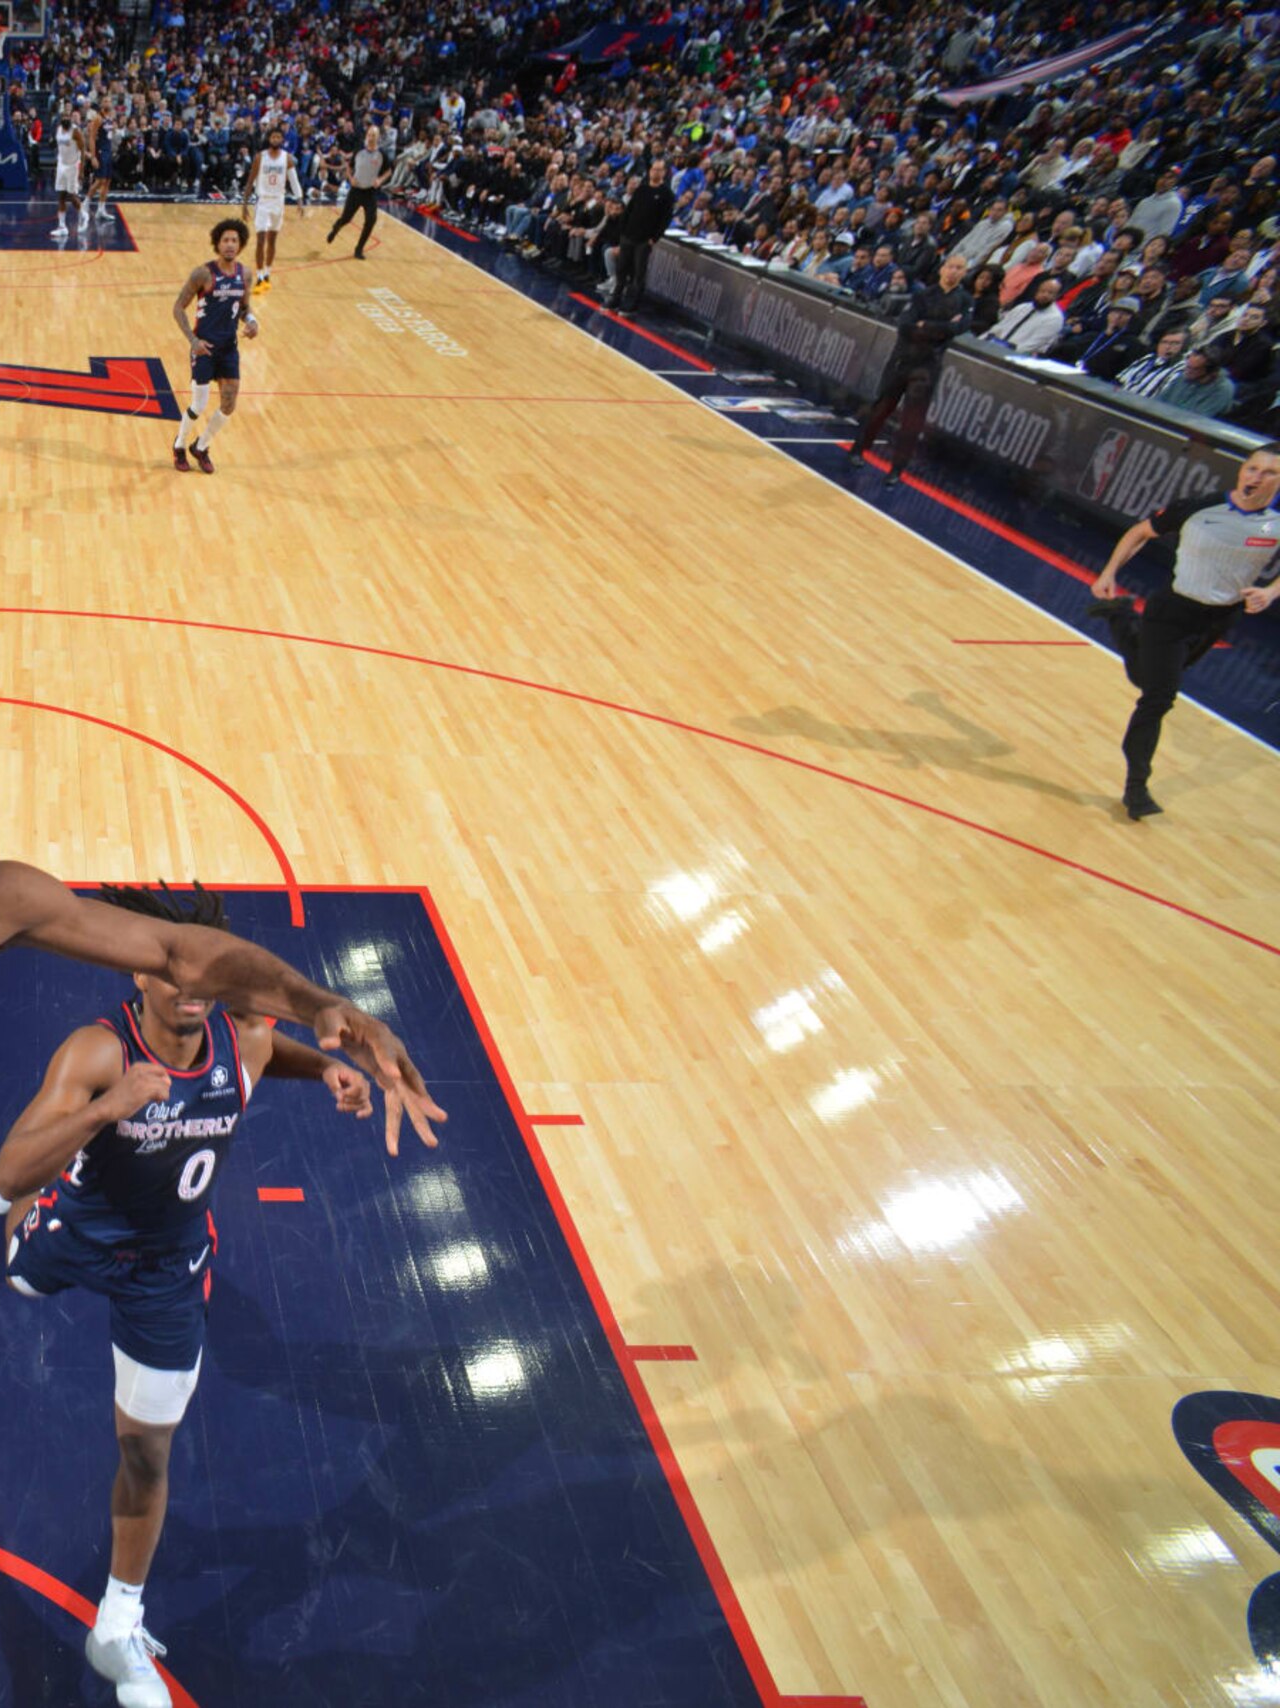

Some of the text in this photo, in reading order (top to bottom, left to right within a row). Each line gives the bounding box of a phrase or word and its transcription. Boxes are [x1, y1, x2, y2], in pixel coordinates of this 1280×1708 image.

[231, 301, 240, 320] 9
[747, 289, 856, 383] NBAStore.com
[145, 1100, 186, 1121] City of
[116, 1112, 239, 1140] BROTHERLY
[177, 1149, 216, 1201] 0
